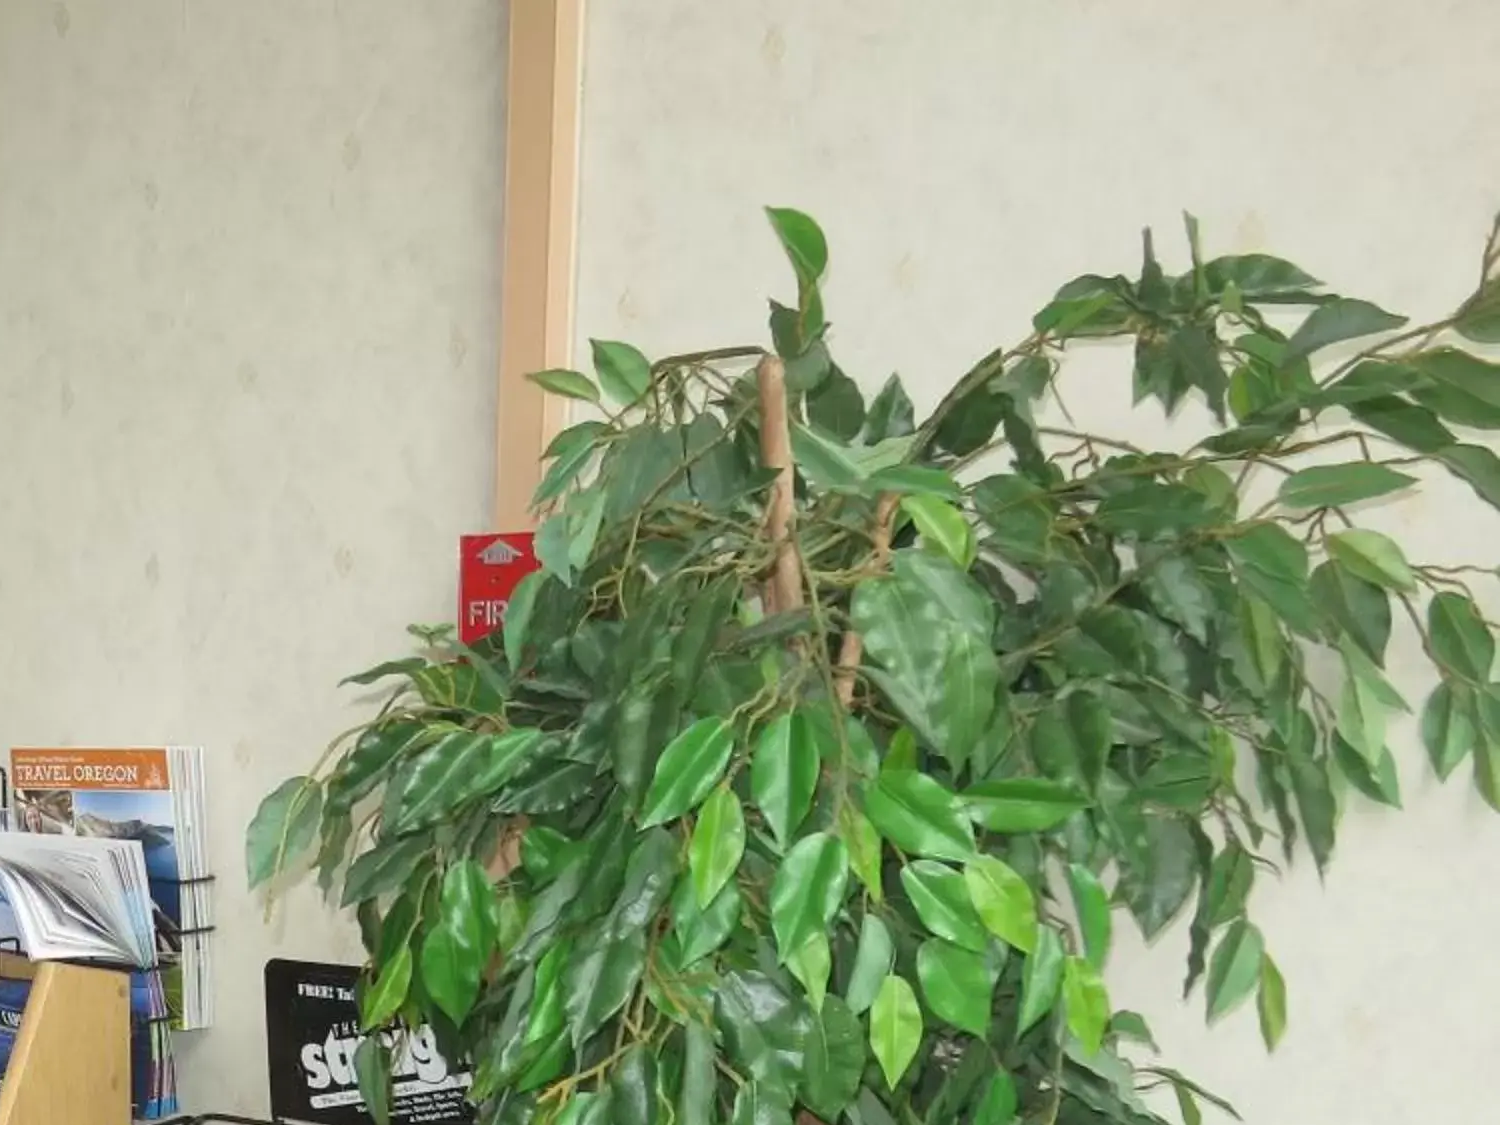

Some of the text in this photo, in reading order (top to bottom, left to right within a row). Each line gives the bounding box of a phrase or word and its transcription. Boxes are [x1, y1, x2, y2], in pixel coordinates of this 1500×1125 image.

[468, 600, 508, 627] FIR
[15, 765, 138, 782] TRAVEL OREGON
[297, 983, 333, 999] FREE!
[332, 1020, 358, 1037] THE
